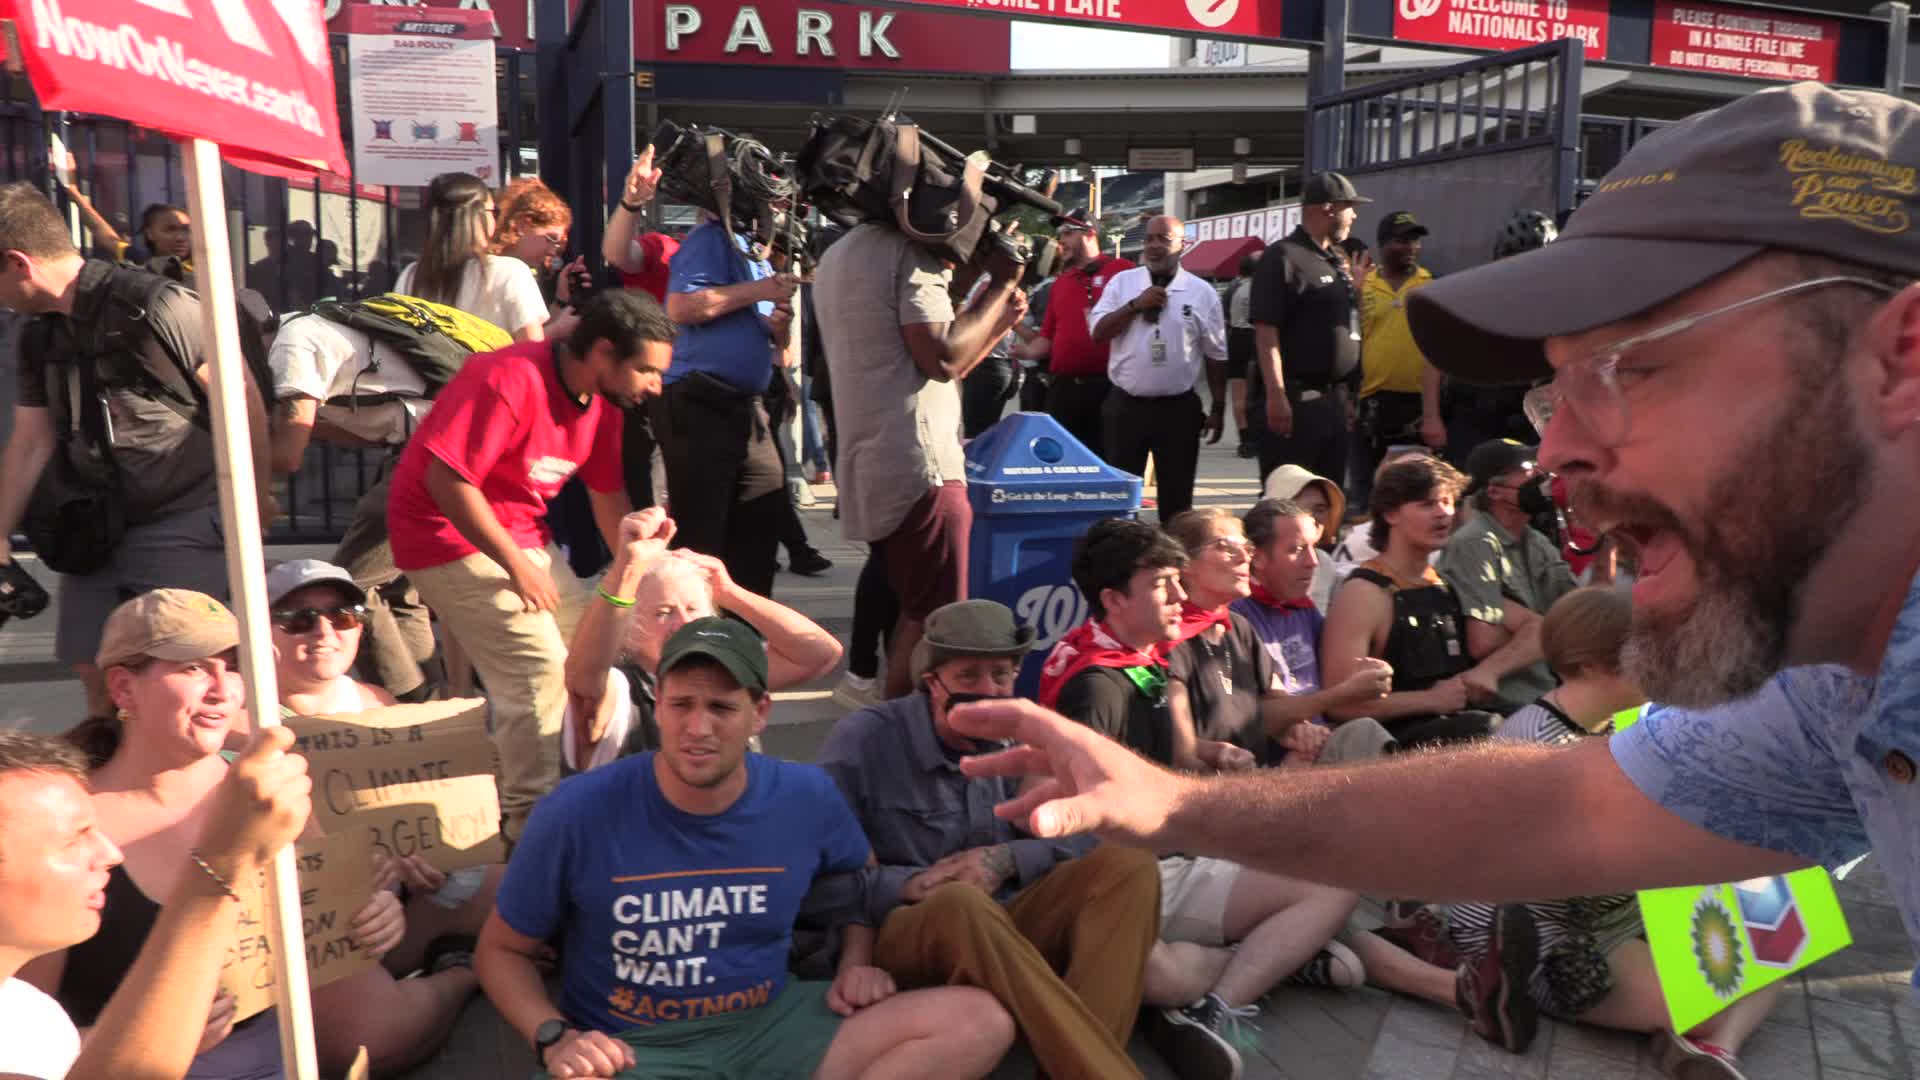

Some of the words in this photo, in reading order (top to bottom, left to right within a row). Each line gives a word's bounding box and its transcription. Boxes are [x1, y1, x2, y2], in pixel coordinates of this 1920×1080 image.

[1546, 0, 1569, 21] TO
[1672, 8, 1715, 29] PLEASE
[664, 3, 901, 59] PARK
[1447, 10, 1548, 43] NATIONALS
[1551, 23, 1600, 49] PARK
[1688, 29, 1702, 47] IN
[1703, 31, 1712, 48] A
[1713, 32, 1753, 53] SINGLE
[1754, 37, 1779, 56] FILE
[1780, 41, 1805, 59] LINE
[1669, 50, 1684, 65] DO
[1685, 52, 1704, 67] NOT
[1791, 173, 1908, 226] Power
[296, 728, 358, 753] THIS
[325, 760, 453, 815] CLIMATE
[370, 805, 487, 858] RGENCY!
[612, 884, 768, 924] CLIMATE
[611, 921, 727, 957] CAN'T
[612, 955, 716, 987] WAIT.
